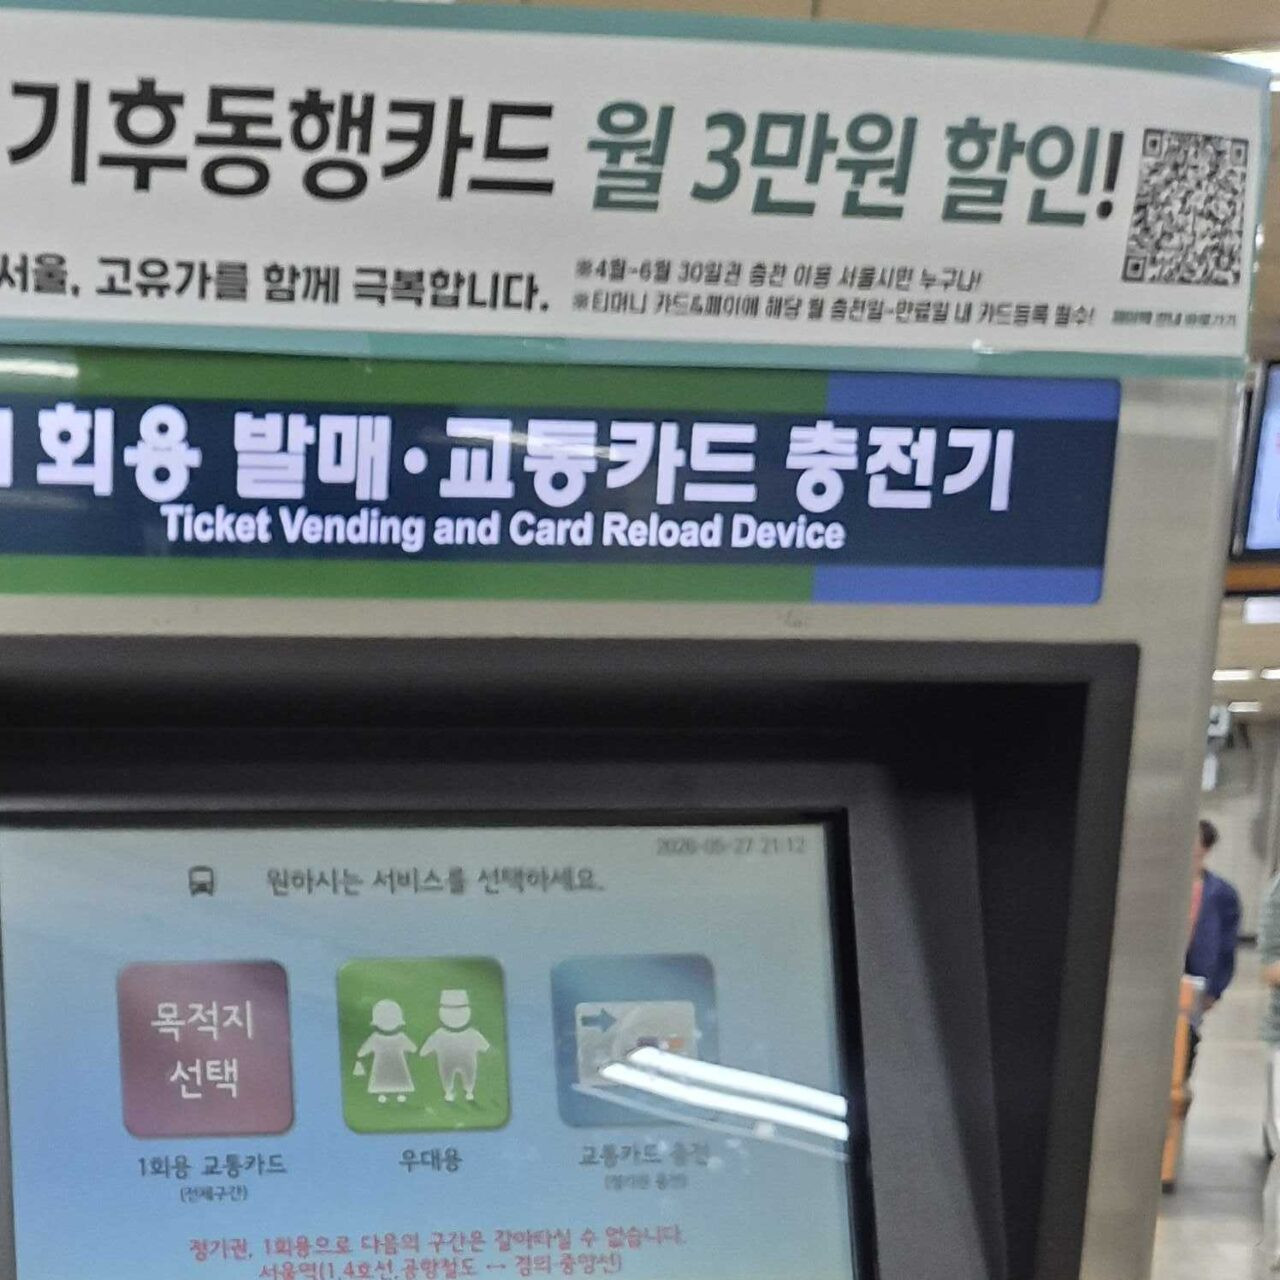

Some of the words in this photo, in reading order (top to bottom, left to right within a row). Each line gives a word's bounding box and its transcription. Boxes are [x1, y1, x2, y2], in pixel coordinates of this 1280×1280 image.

[8, 78, 554, 201] 기후동행카드
[587, 101, 675, 211] 월
[690, 112, 918, 220] 3만원
[941, 117, 1124, 226] 할인!
[95, 257, 248, 302] 고유가를
[264, 263, 340, 305] 함께
[353, 267, 548, 312] 극복합니다.
[234, 412, 757, 508] 발매·교통카드
[785, 419, 1015, 512] 충전기
[161, 505, 271, 543] Ticket
[280, 508, 425, 551] Vending
[434, 510, 500, 545] and
[509, 510, 593, 547] Card
[603, 512, 722, 548] Reload
[731, 514, 846, 550] Device
[267, 867, 363, 896] 원하시는
[372, 867, 465, 895] 서비스를
[478, 866, 605, 895] 선택하세요.
[151, 1000, 253, 1042] 목적지
[169, 1059, 238, 1099] 선택
[138, 1155, 191, 1178] 1회용
[201, 1154, 287, 1178] 교통카드
[399, 1149, 462, 1172] 우대용
[264, 1234, 353, 1258] 1회용으로
[360, 1231, 419, 1255] 다음의
[428, 1230, 485, 1253] 구간은
[580, 1227, 599, 1248] 수
